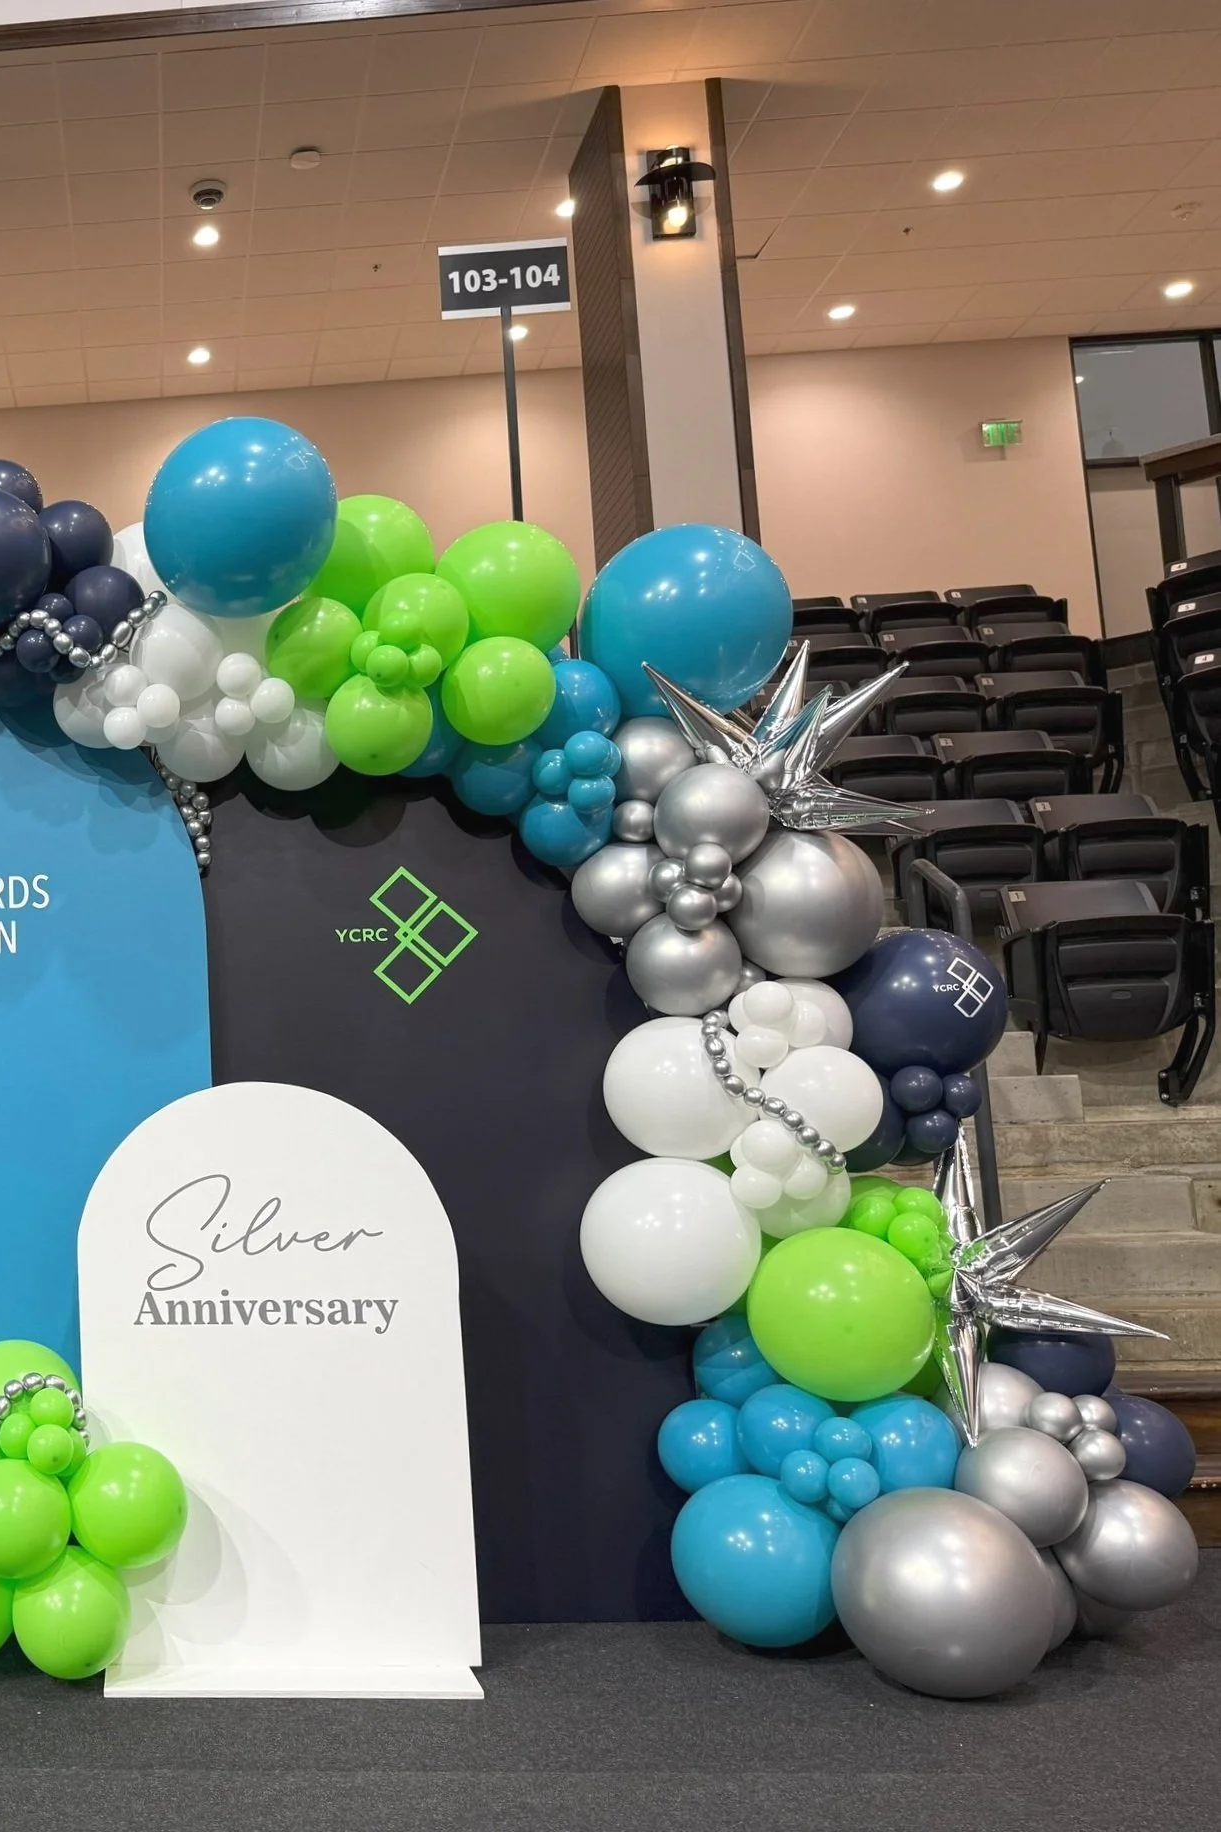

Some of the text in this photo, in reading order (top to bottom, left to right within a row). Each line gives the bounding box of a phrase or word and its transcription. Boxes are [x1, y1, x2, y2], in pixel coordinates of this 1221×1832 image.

[448, 263, 561, 294] 103-104
[334, 927, 389, 943] YCRC
[932, 983, 960, 993] YCRC
[146, 1173, 384, 1292] Silver
[133, 1289, 399, 1335] Anniversary
